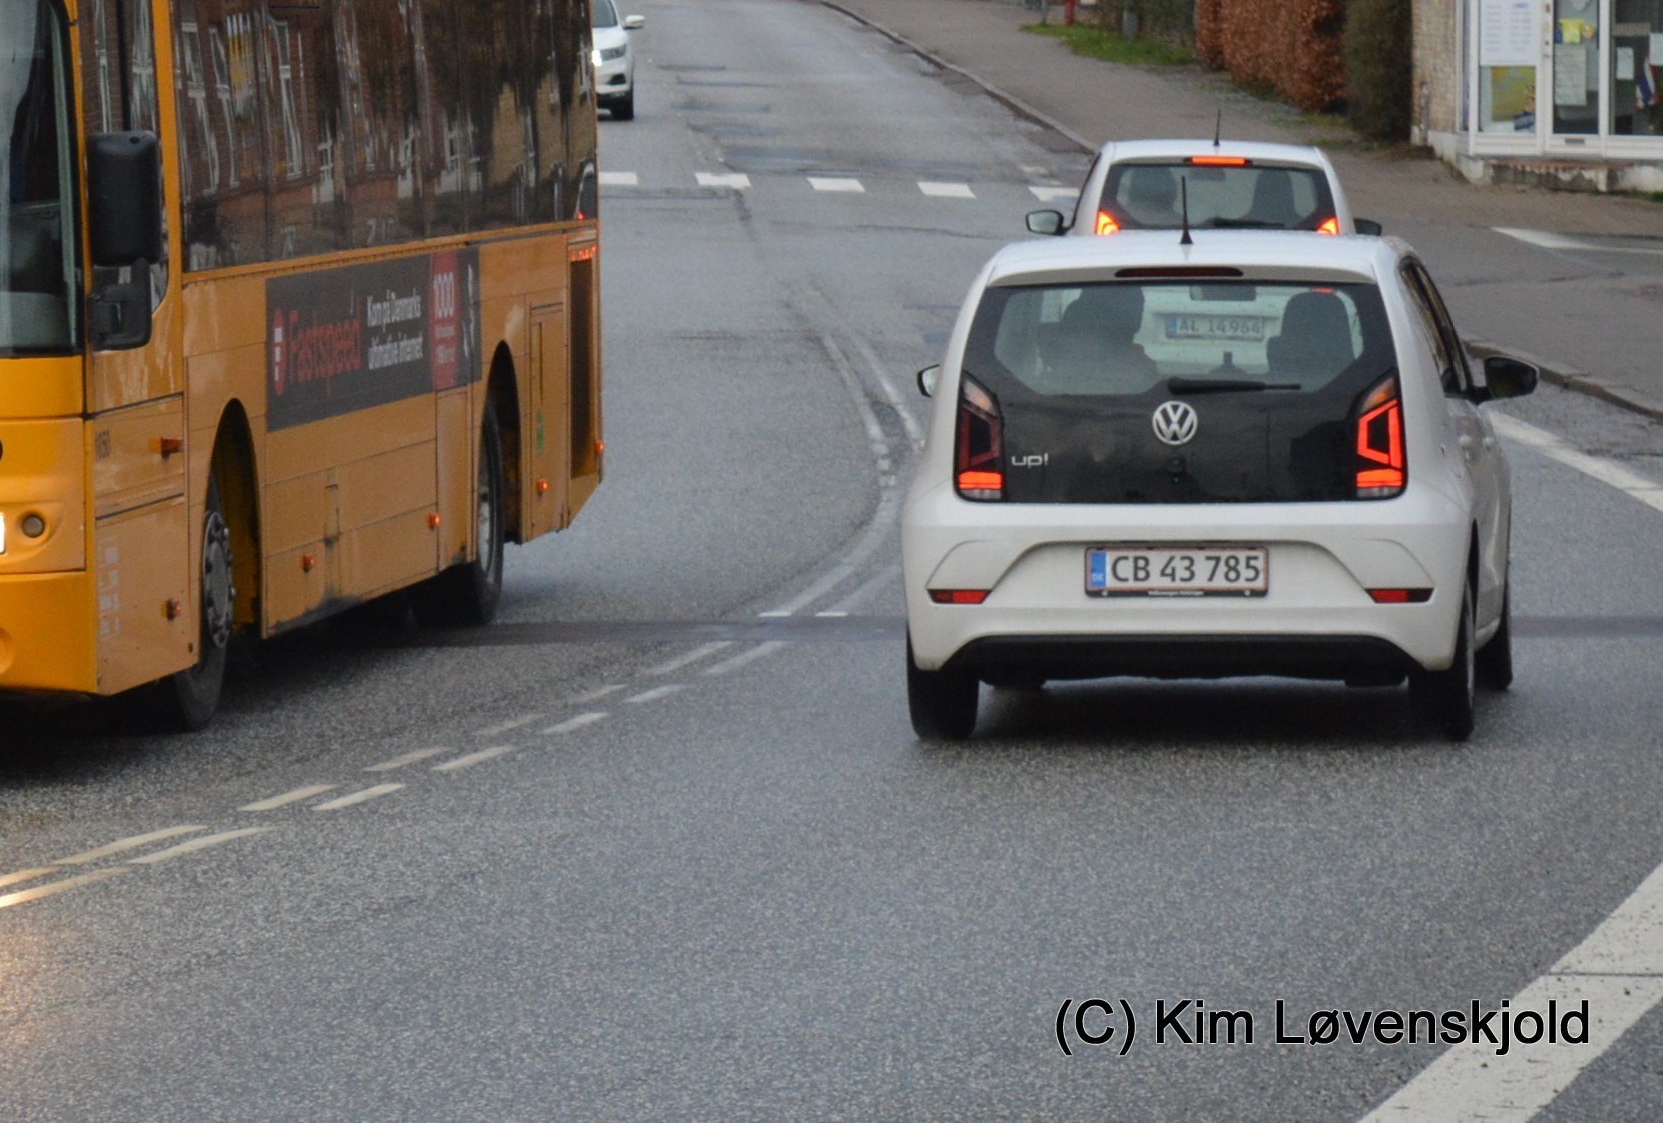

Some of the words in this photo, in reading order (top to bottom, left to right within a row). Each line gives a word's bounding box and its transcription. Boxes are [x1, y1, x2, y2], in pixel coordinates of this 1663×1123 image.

[367, 295, 382, 327] Kom
[433, 272, 455, 319] 1000
[289, 296, 362, 397] Fastspeed
[1011, 452, 1048, 468] up!
[1111, 556, 1150, 582] CB
[1160, 556, 1196, 582] 43
[1205, 555, 1260, 582] 785
